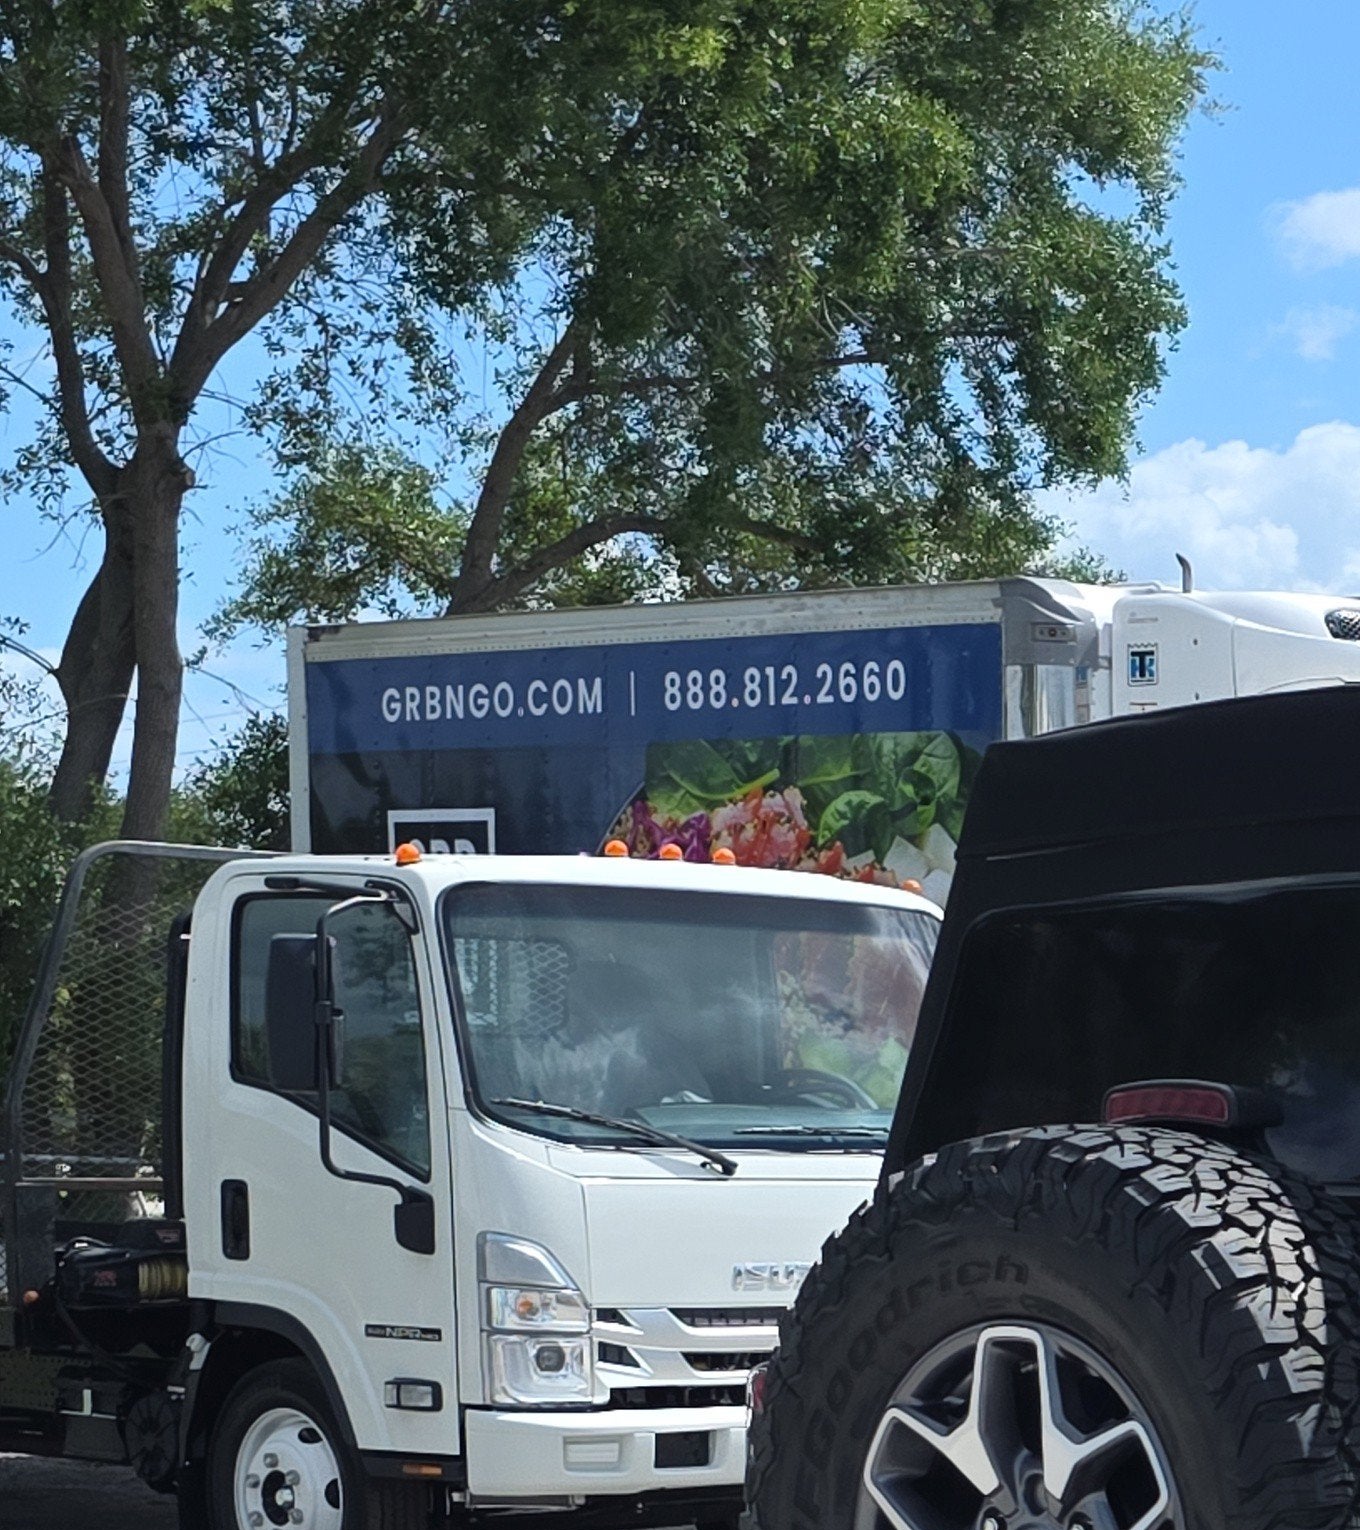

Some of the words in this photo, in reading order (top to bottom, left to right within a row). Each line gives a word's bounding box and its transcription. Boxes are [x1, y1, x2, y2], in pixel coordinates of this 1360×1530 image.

[381, 677, 603, 723] GRBNGO.COM
[663, 659, 907, 711] 888.812.2660
[732, 1261, 815, 1292] ISUZ
